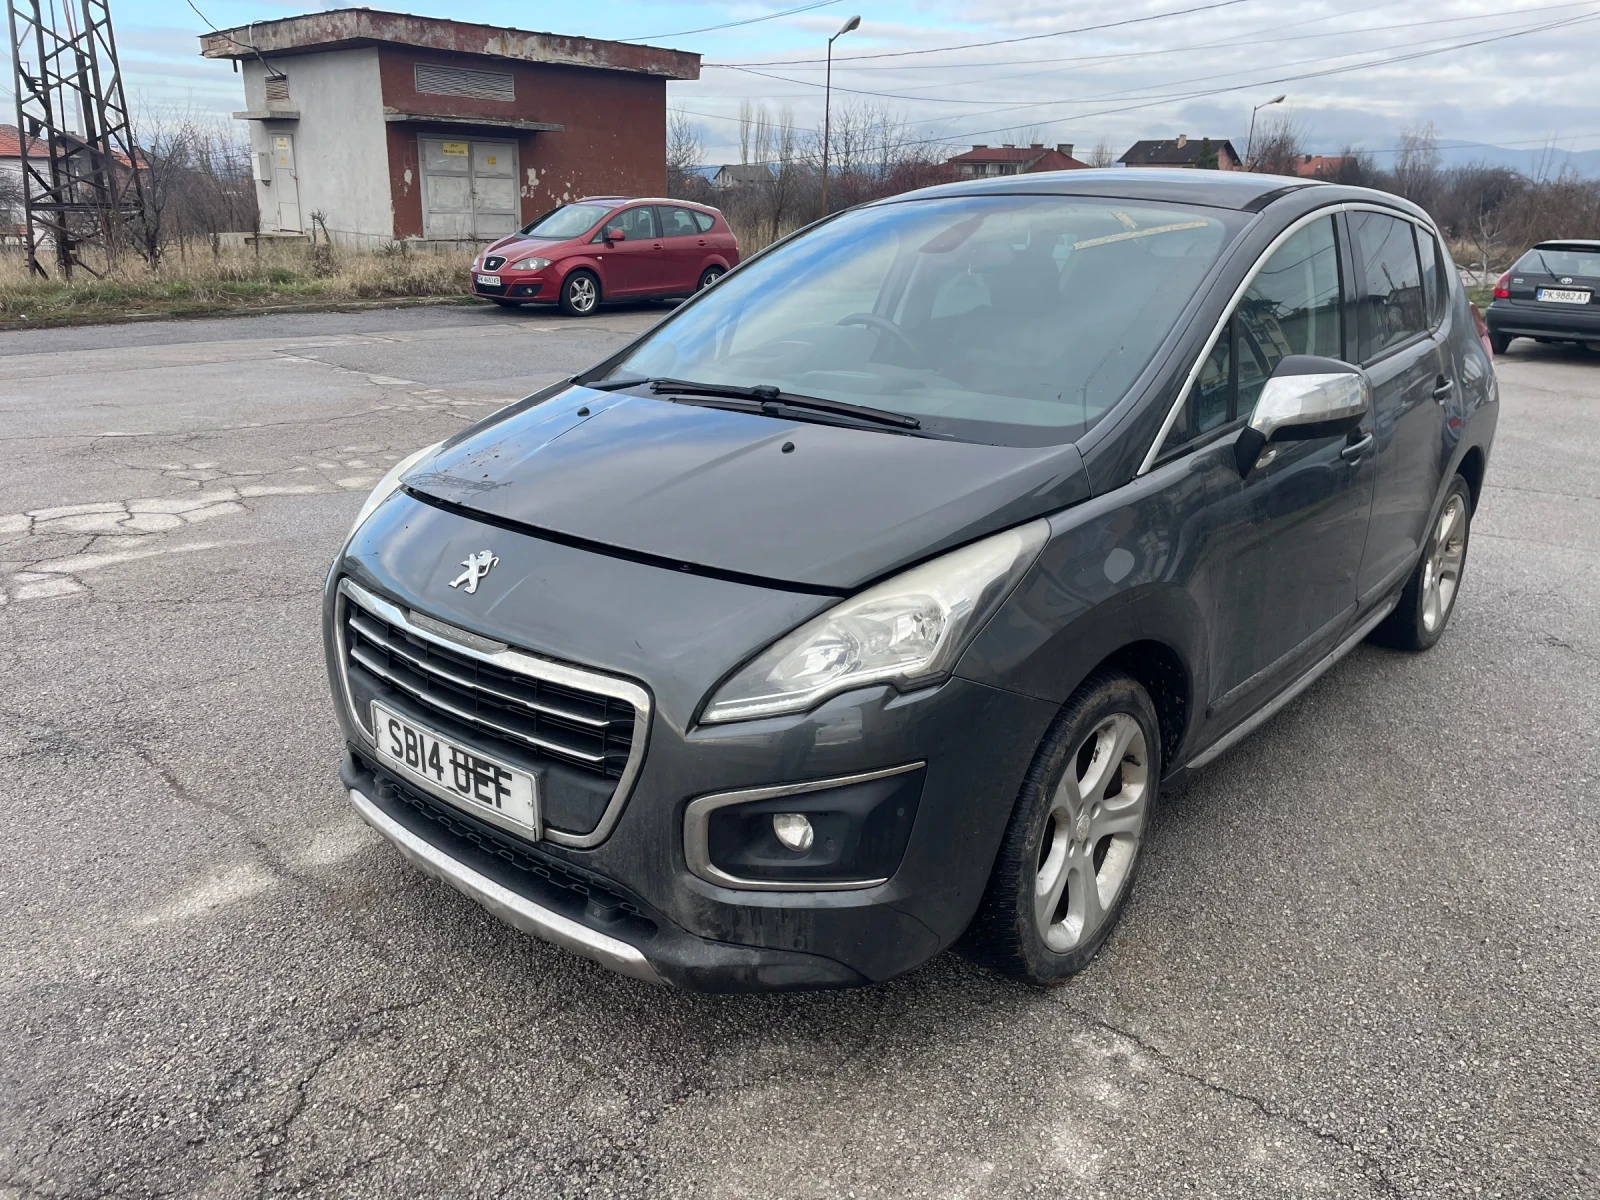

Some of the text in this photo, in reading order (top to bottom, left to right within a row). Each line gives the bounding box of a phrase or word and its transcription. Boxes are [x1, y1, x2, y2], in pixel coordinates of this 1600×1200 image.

[1543, 290, 1588, 302] PK 9882 AT
[388, 718, 444, 781] SB14
